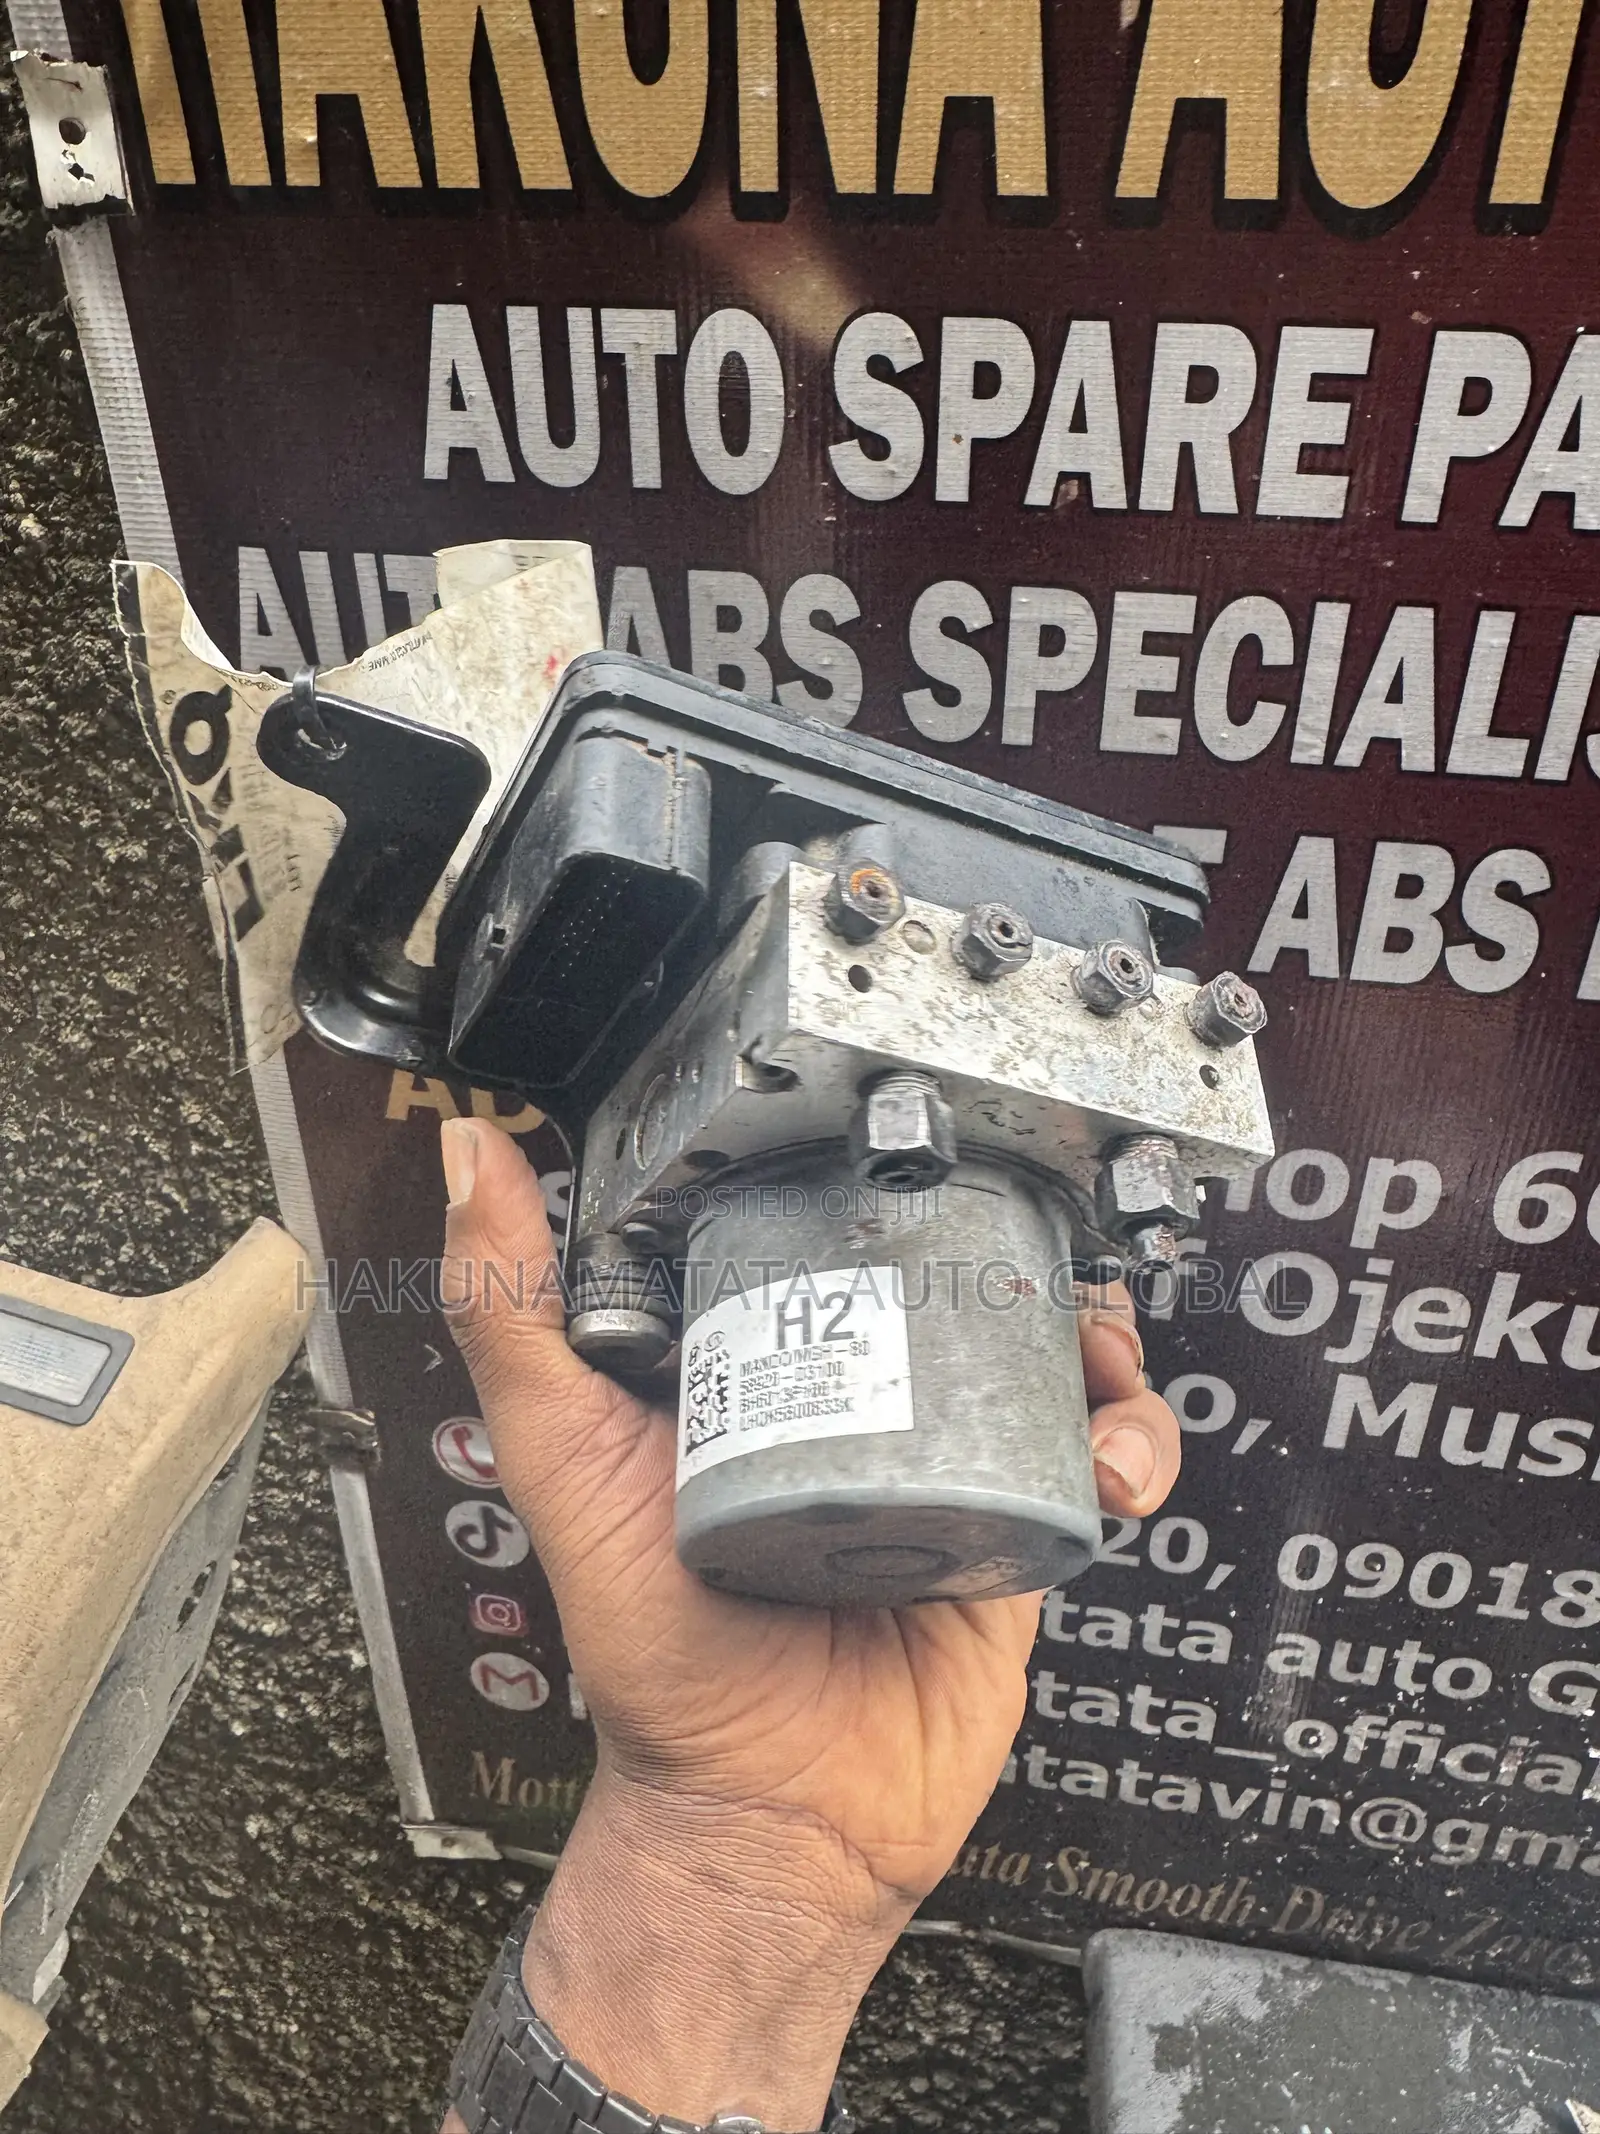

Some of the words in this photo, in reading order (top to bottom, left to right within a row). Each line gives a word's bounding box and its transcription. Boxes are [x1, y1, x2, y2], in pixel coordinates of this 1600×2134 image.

[424, 303, 785, 496] AUTO
[829, 311, 1375, 520] SPARE
[1401, 329, 1600, 531] PA
[237, 546, 440, 682] AUT
[606, 566, 863, 732] ABS
[903, 579, 1600, 783] SPECIALI
[1247, 835, 1552, 994] ABS
[1493, 1151, 1600, 1245] 6
[773, 1290, 856, 1350] H2
[1323, 1374, 1600, 1482] Mus
[1266, 1632, 1493, 1700] auto
[1043, 1846, 1256, 1927] Smooth
